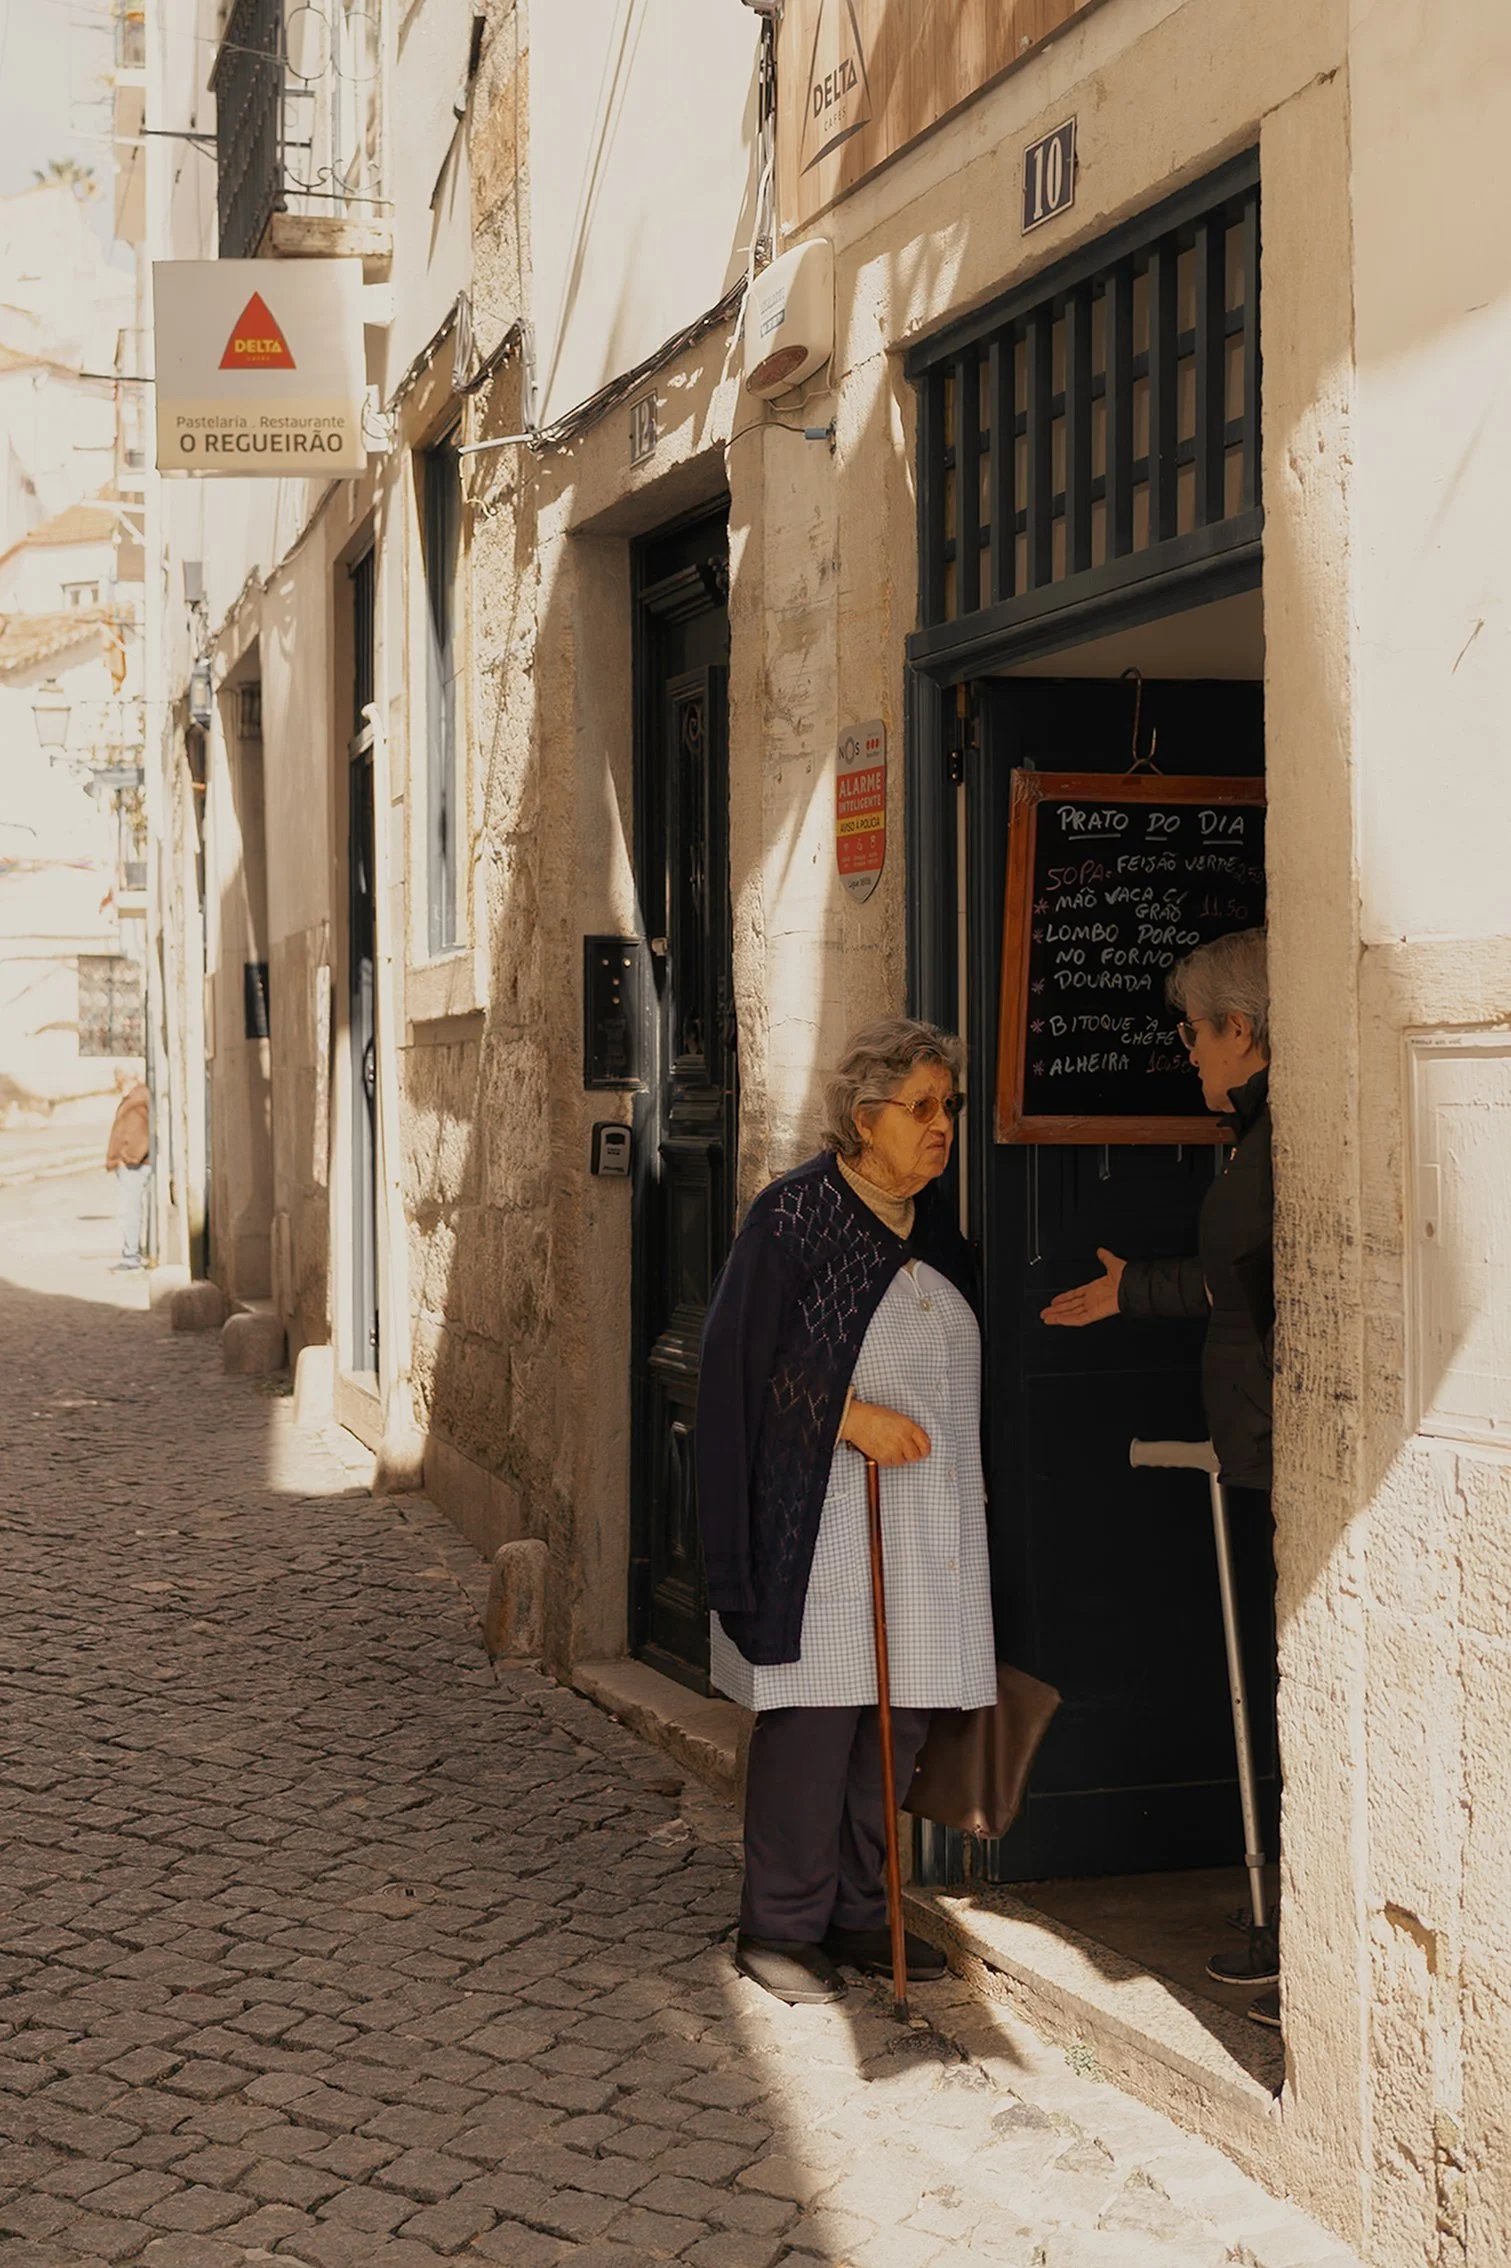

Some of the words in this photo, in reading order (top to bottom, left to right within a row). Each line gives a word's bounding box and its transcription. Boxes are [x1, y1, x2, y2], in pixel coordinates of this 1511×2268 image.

[813, 57, 858, 119] DELTA
[1033, 137, 1063, 220] 10
[234, 339, 283, 353] DELTA
[176, 416, 247, 429] Pastelaria
[260, 416, 345, 429] Restaurante
[180, 433, 196, 453] O
[205, 429, 343, 453] REGUEIRÃO
[839, 736, 860, 765] NOS
[839, 772, 881, 799] ALARME
[1057, 805, 1129, 832] PRATO
[1146, 812, 1180, 832] DO
[1198, 810, 1244, 835] DIA
[1117, 852, 1177, 874] FEIJÃO
[1185, 854, 1239, 873] VERDE
[1055, 887, 1098, 912] MÃO
[1104, 886, 1154, 905] VACA
[1135, 902, 1182, 923] GRÃO
[1046, 922, 1120, 943] LOMBO
[1137, 923, 1200, 946] PORCO
[1056, 948, 1086, 966] NO
[1101, 947, 1174, 968] FORNO
[1054, 969, 1152, 993] DOURADA
[1049, 1013, 1135, 1037] BITOQUE
[1120, 1030, 1178, 1046] CHEFE
[1049, 1051, 1130, 1076] ALHEIRA
